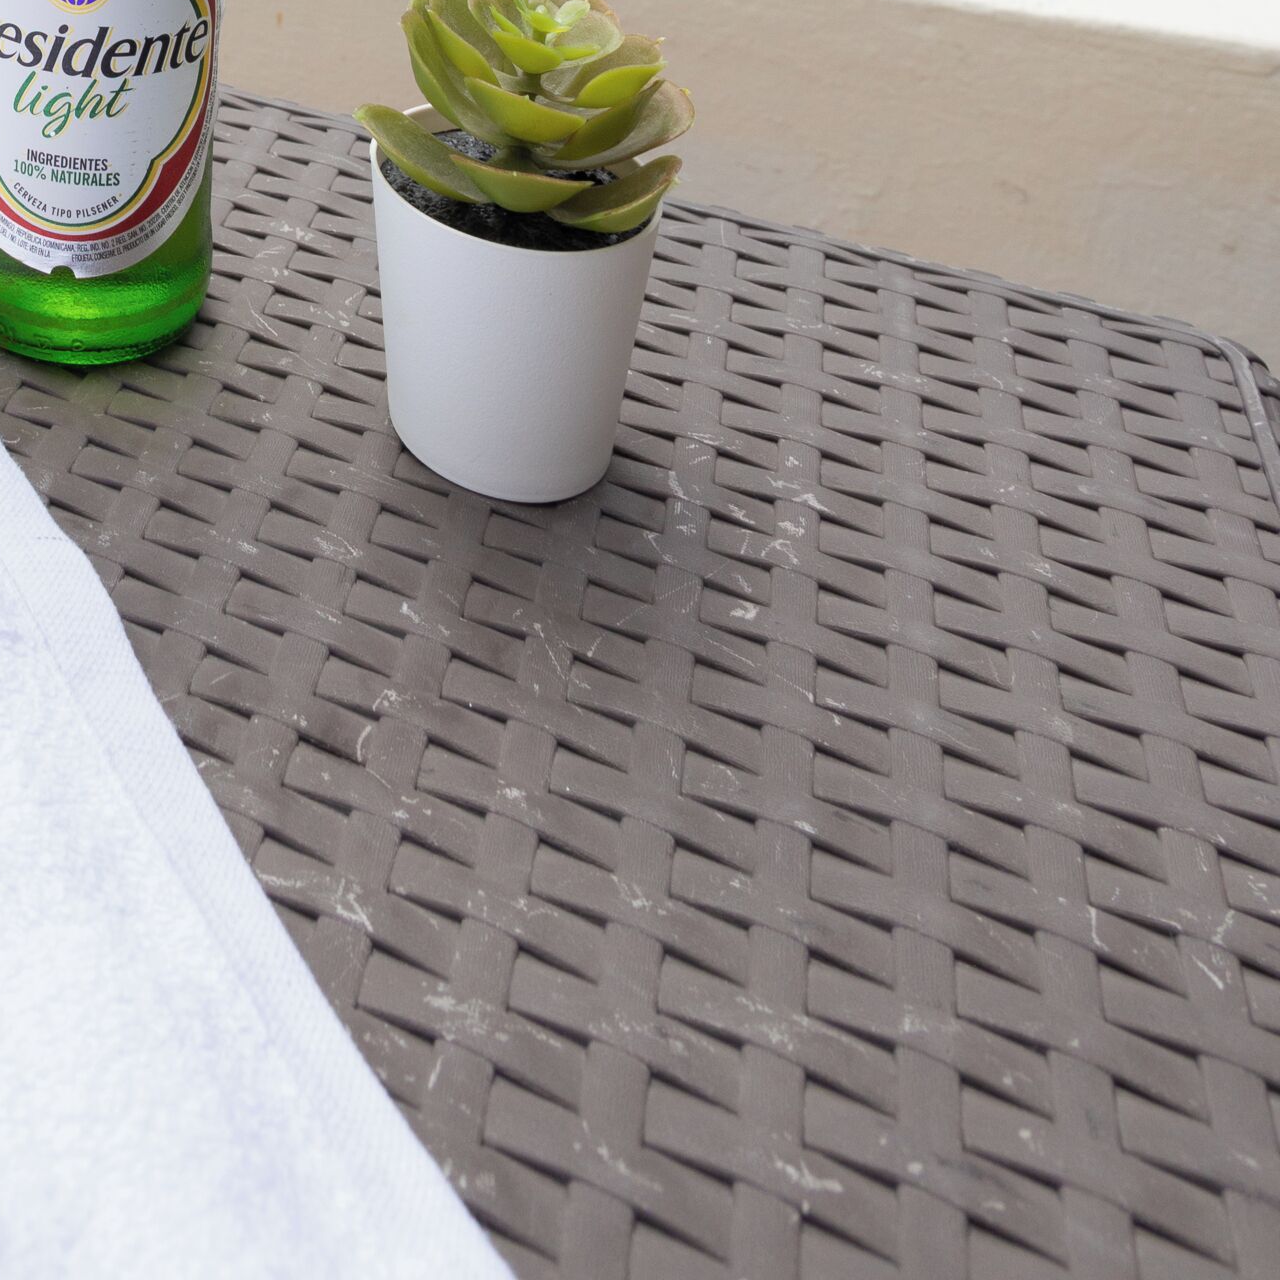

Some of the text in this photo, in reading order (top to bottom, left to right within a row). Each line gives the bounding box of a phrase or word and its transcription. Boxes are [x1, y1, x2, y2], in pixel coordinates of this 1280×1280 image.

[12, 70, 134, 139] light
[13, 159, 121, 187] 100% NATURALES
[26, 148, 109, 172] INGREDIENTES
[13, 183, 119, 219] CERVEZA TIPO PILSENER
[43, 249, 51, 259] LA
